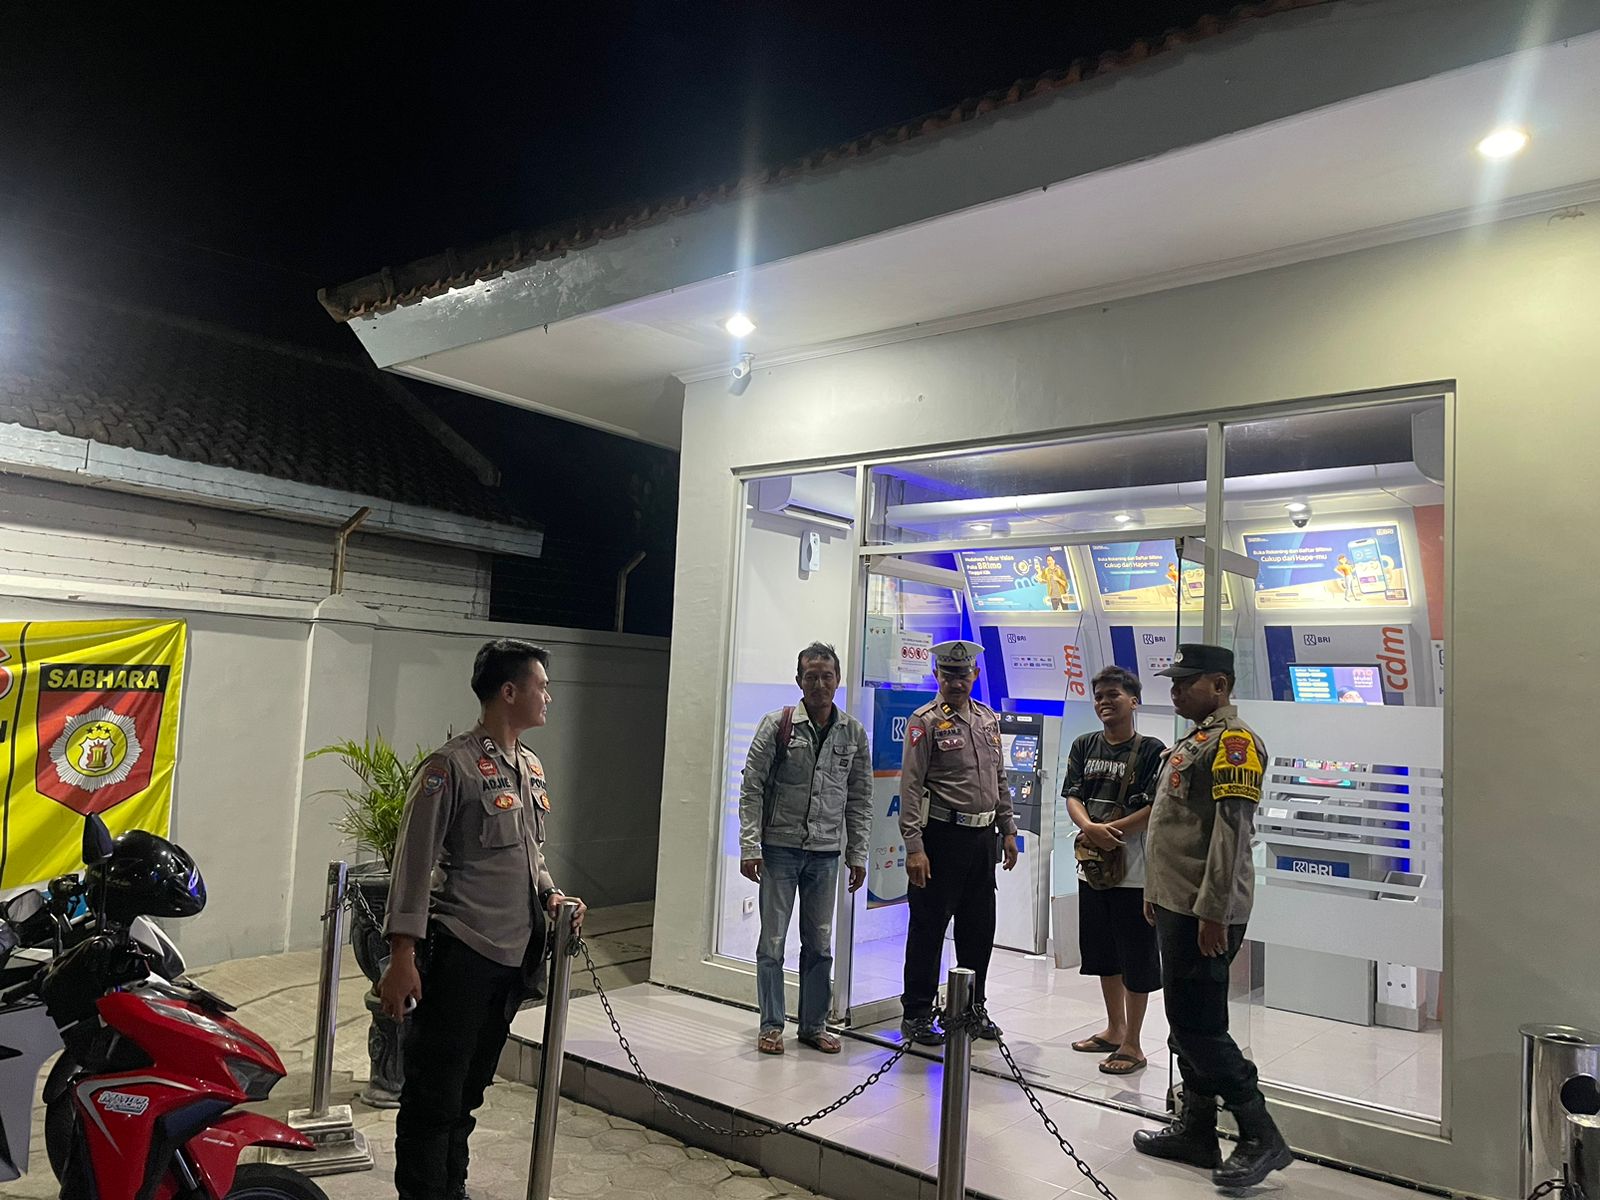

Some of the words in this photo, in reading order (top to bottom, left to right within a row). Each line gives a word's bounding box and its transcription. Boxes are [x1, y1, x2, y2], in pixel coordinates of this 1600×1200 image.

[977, 561, 1002, 570] BRImo
[1295, 554, 1328, 562] Hape-mu
[1376, 626, 1409, 691] cdm
[1063, 645, 1085, 696] atm
[47, 669, 160, 690] SABHARA
[482, 776, 512, 791] ADJIE
[1309, 863, 1332, 877] BRI
